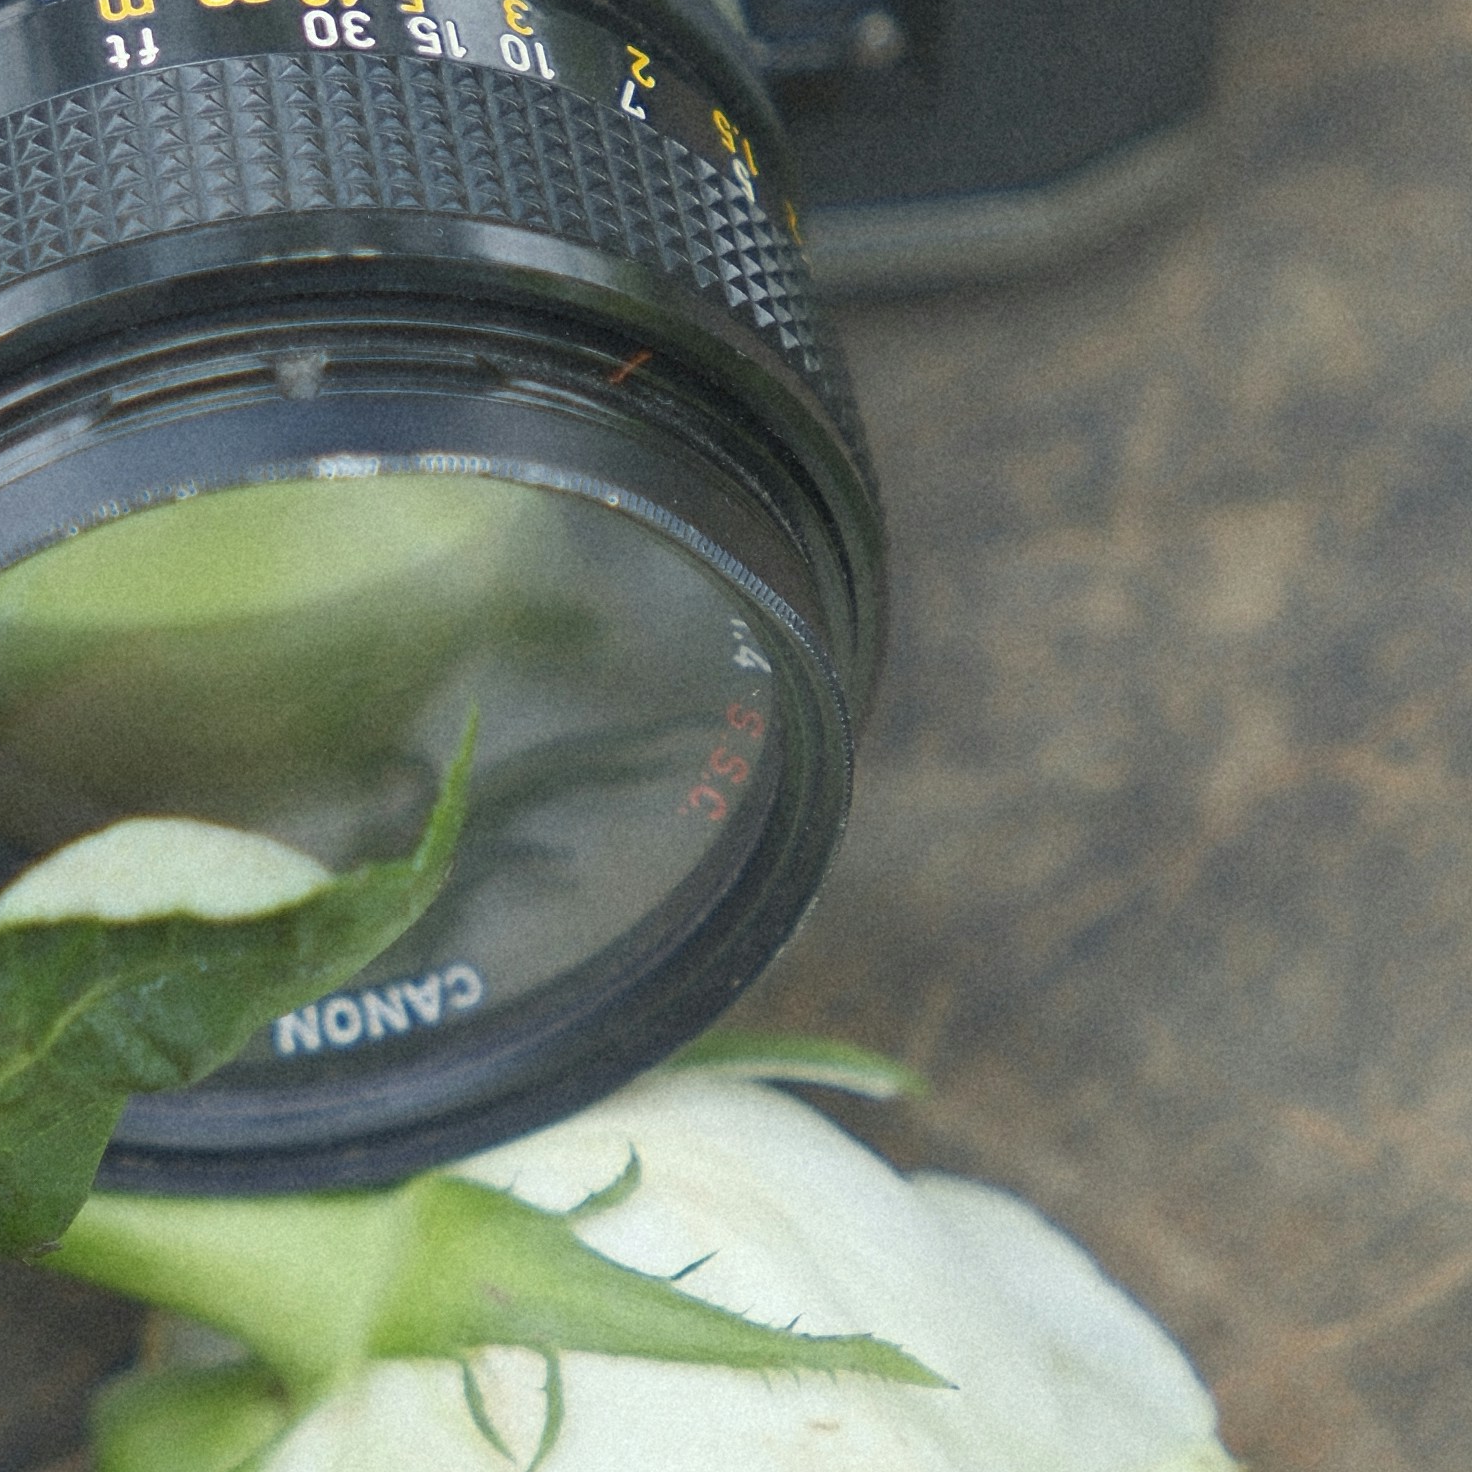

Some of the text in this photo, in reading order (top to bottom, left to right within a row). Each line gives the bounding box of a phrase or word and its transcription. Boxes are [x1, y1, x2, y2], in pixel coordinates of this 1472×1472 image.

[106, 27, 159, 69] ft
[303, 9, 376, 48] 30
[408, 16, 467, 59] 15
[500, 35, 555, 80] 10
[626, 44, 656, 89] 2
[276, 965, 484, 1055] CANON
